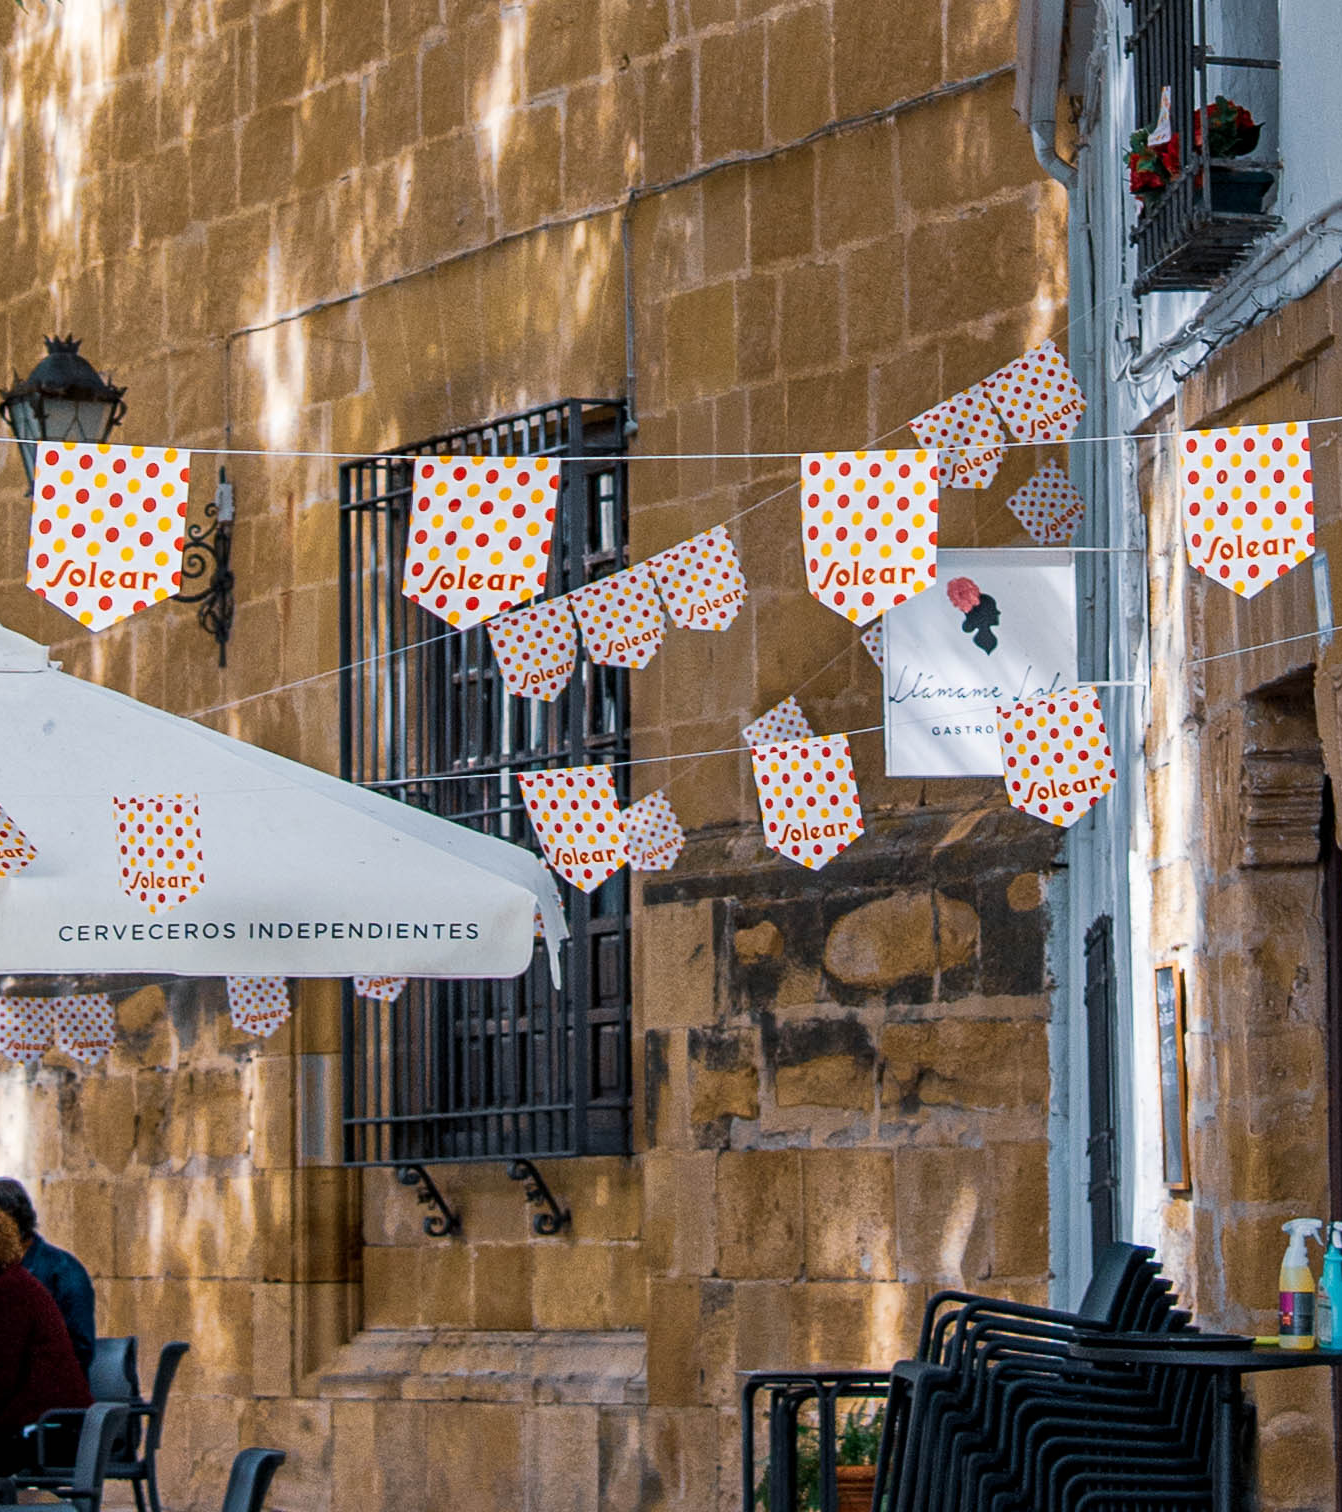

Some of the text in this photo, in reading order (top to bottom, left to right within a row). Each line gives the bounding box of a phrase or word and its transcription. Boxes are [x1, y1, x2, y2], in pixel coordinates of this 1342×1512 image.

[1202, 535, 1297, 564] Solear
[45, 559, 158, 591] Solear
[420, 564, 525, 592] Solear
[817, 559, 916, 589] Solear
[1012, 665, 1067, 701] Lol
[59, 921, 479, 942] CERVECEROS INDEPENDIENTES
